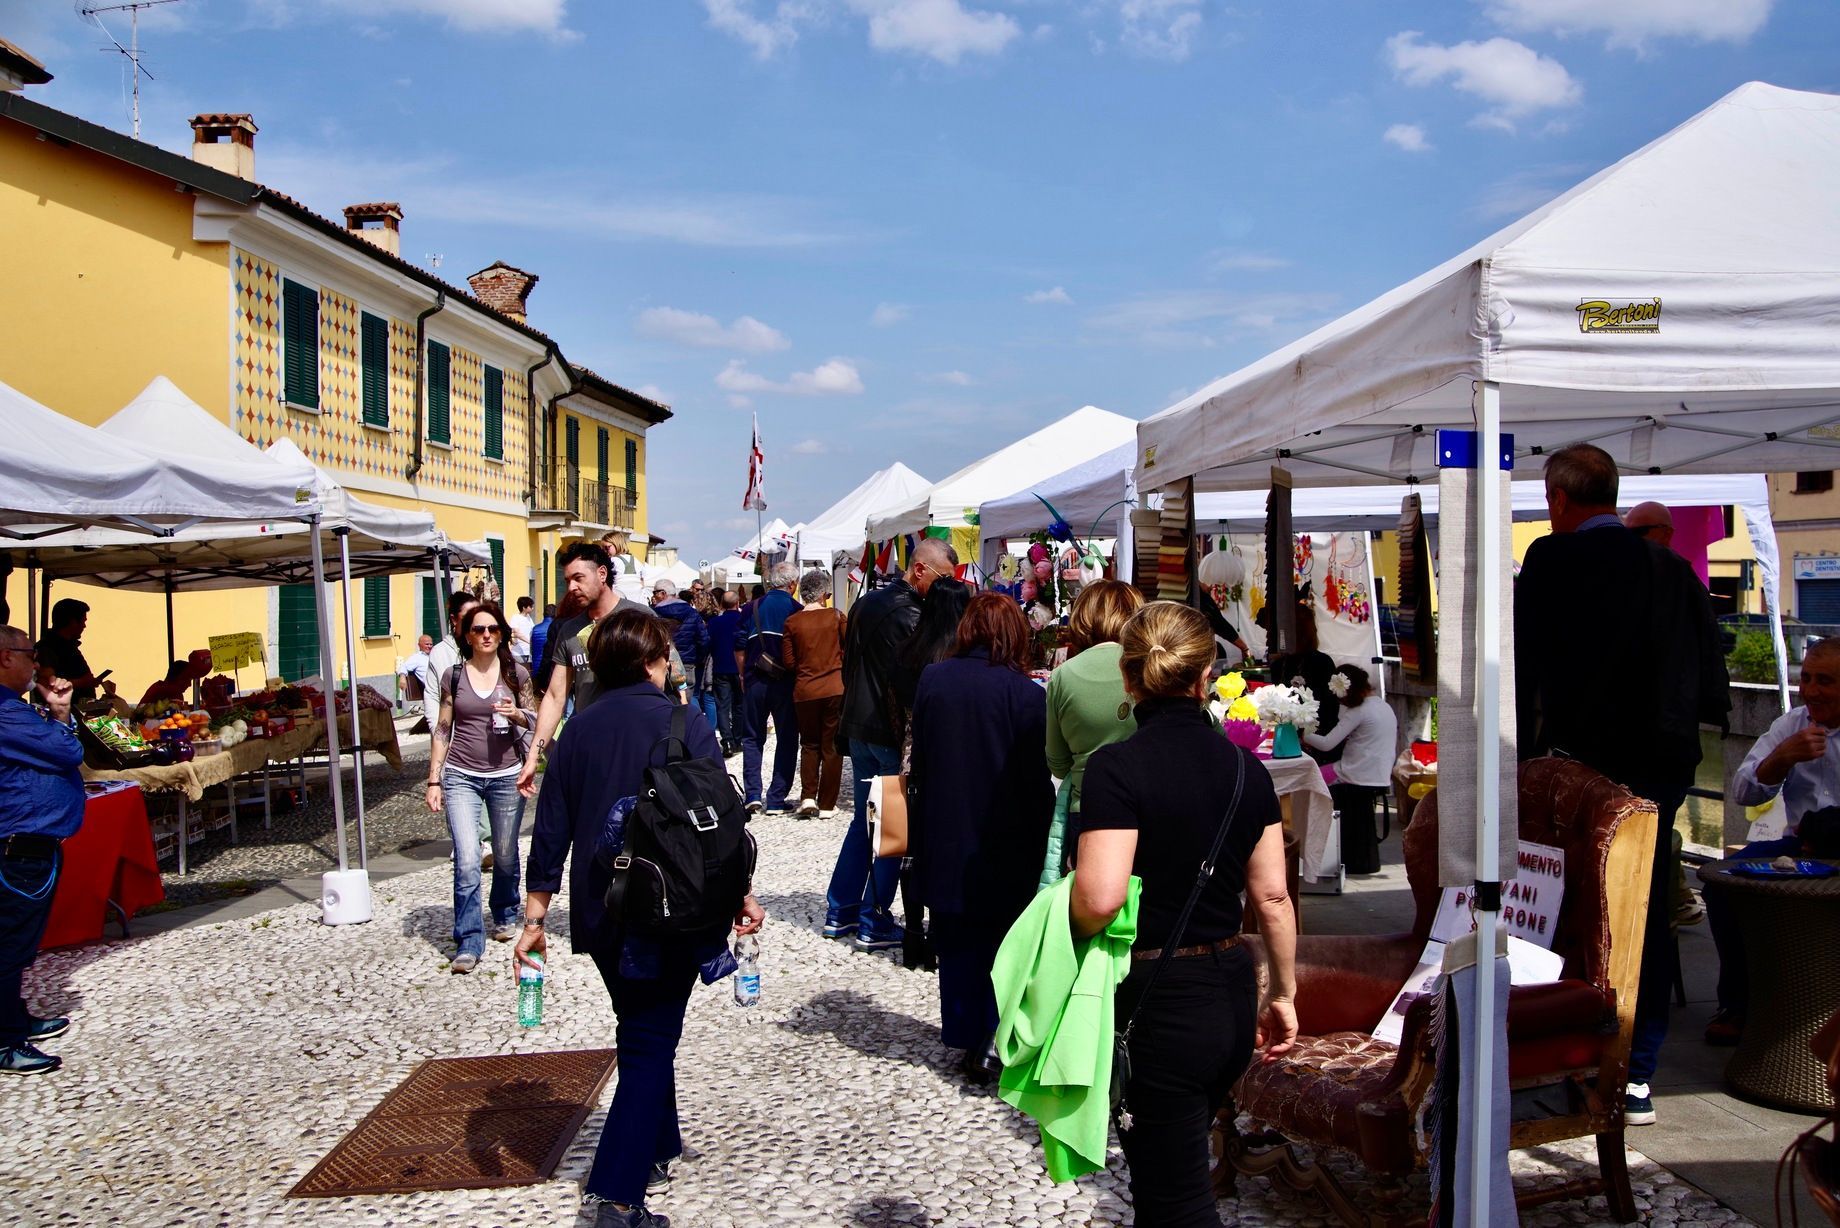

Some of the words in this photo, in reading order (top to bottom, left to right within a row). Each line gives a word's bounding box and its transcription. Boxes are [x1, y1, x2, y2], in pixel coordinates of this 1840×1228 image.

[1576, 297, 1660, 331] Bertoni
[1517, 851, 1562, 878] IMENTO
[1501, 881, 1538, 905] VANI
